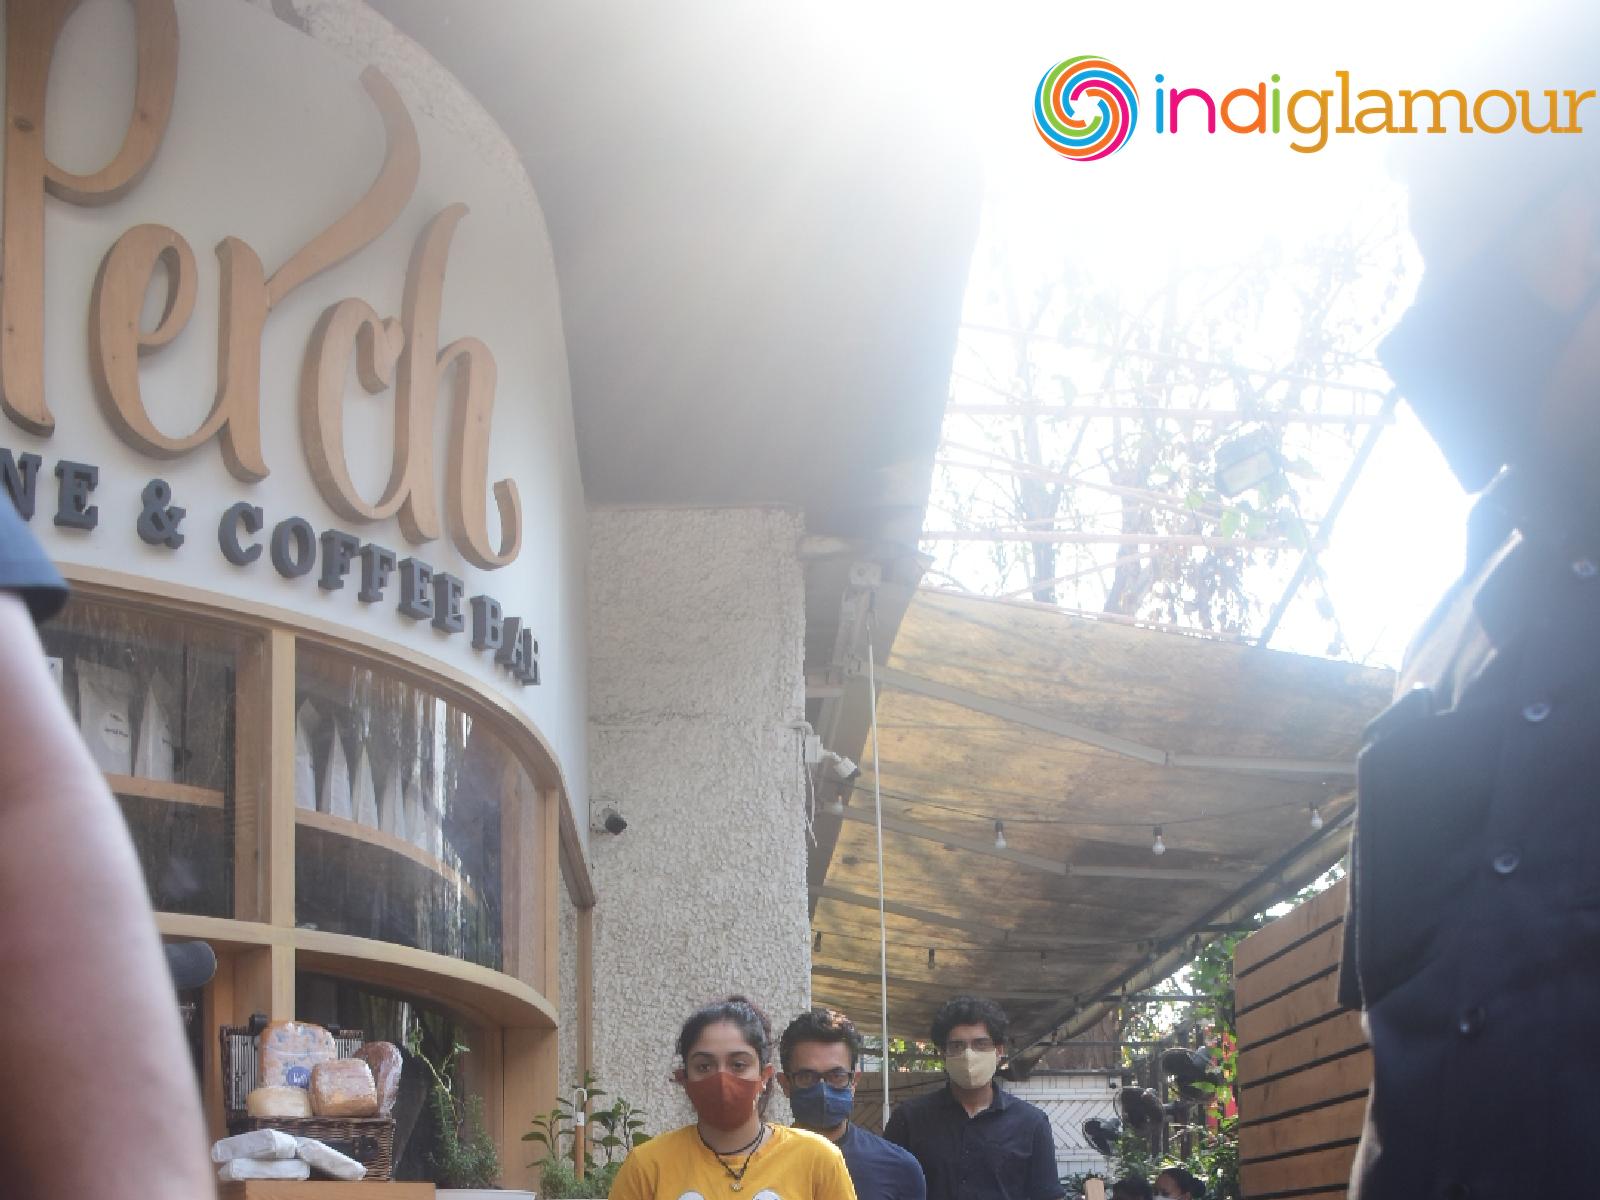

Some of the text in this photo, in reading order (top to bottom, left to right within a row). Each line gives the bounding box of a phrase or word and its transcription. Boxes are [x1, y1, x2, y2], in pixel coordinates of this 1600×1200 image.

[2, 0, 523, 570] Perch
[137, 478, 187, 550] &
[218, 502, 464, 635] COFFEE
[469, 594, 541, 686] BAR
